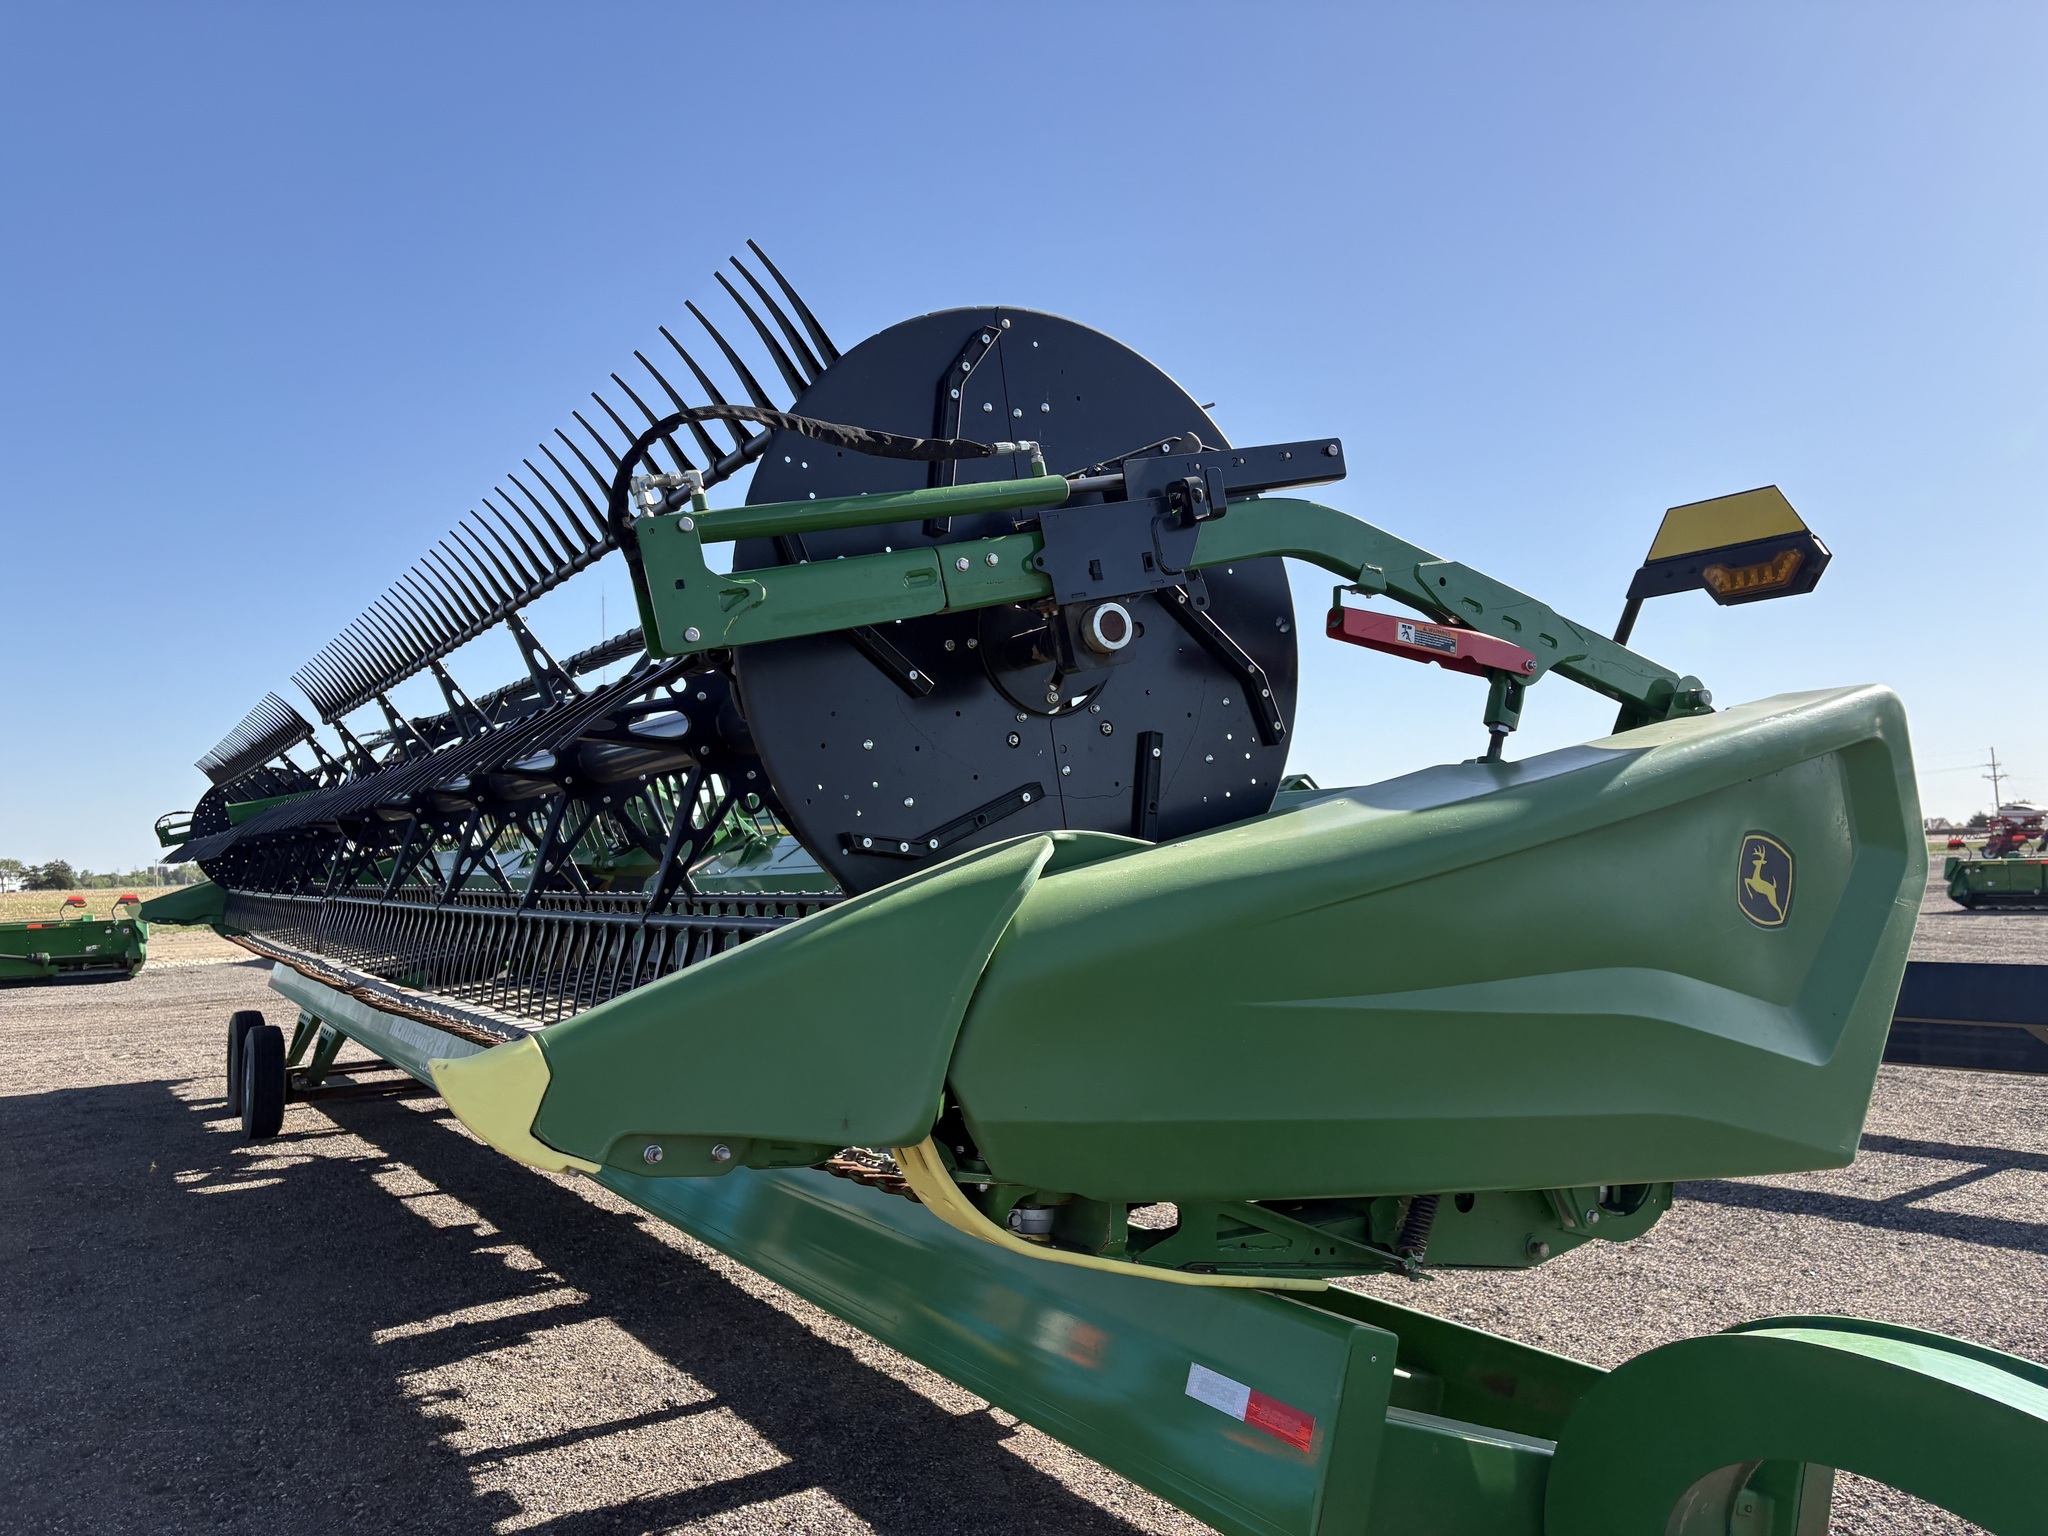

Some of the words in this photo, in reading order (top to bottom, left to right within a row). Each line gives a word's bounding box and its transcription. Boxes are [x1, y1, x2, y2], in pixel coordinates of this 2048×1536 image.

[1186, 462, 1191, 473] 1
[1231, 456, 1239, 468] 2
[1278, 451, 1286, 462] 3
